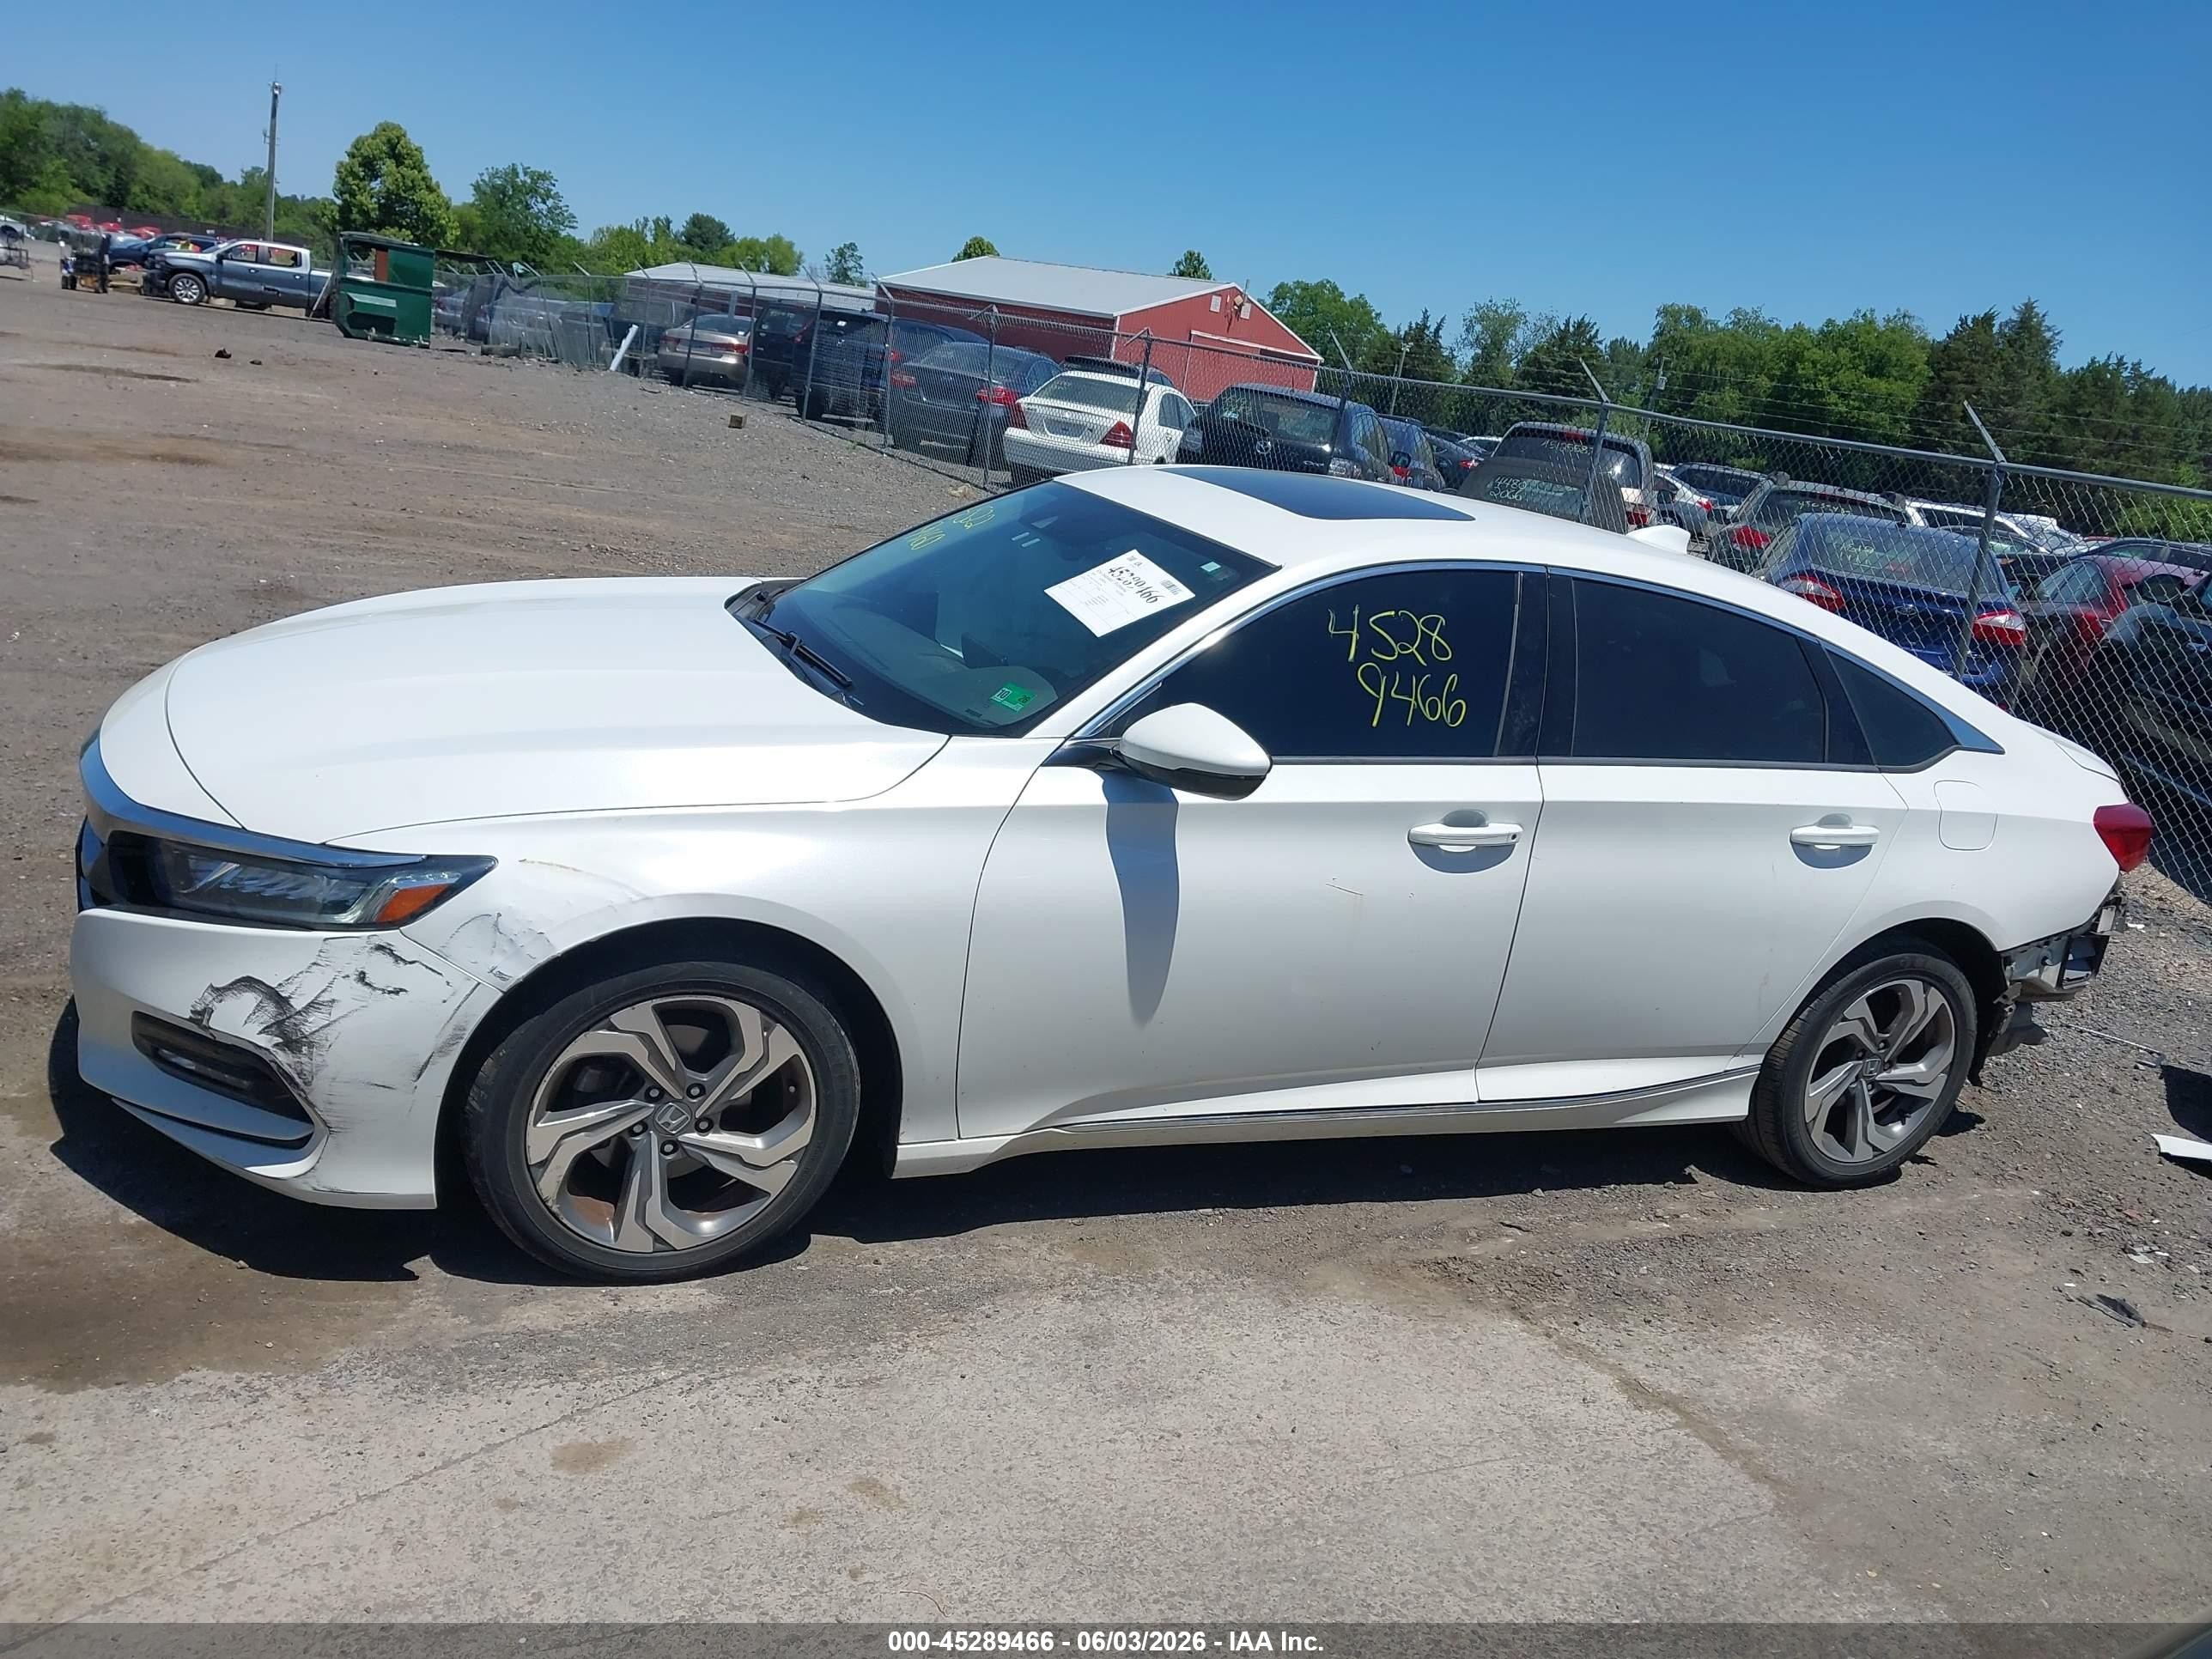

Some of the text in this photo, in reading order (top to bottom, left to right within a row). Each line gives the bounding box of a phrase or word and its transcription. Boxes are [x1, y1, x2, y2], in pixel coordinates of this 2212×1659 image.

[1328, 604, 1453, 667] 4528
[997, 689, 1011, 699] 10
[1358, 662, 1467, 727] 9466
